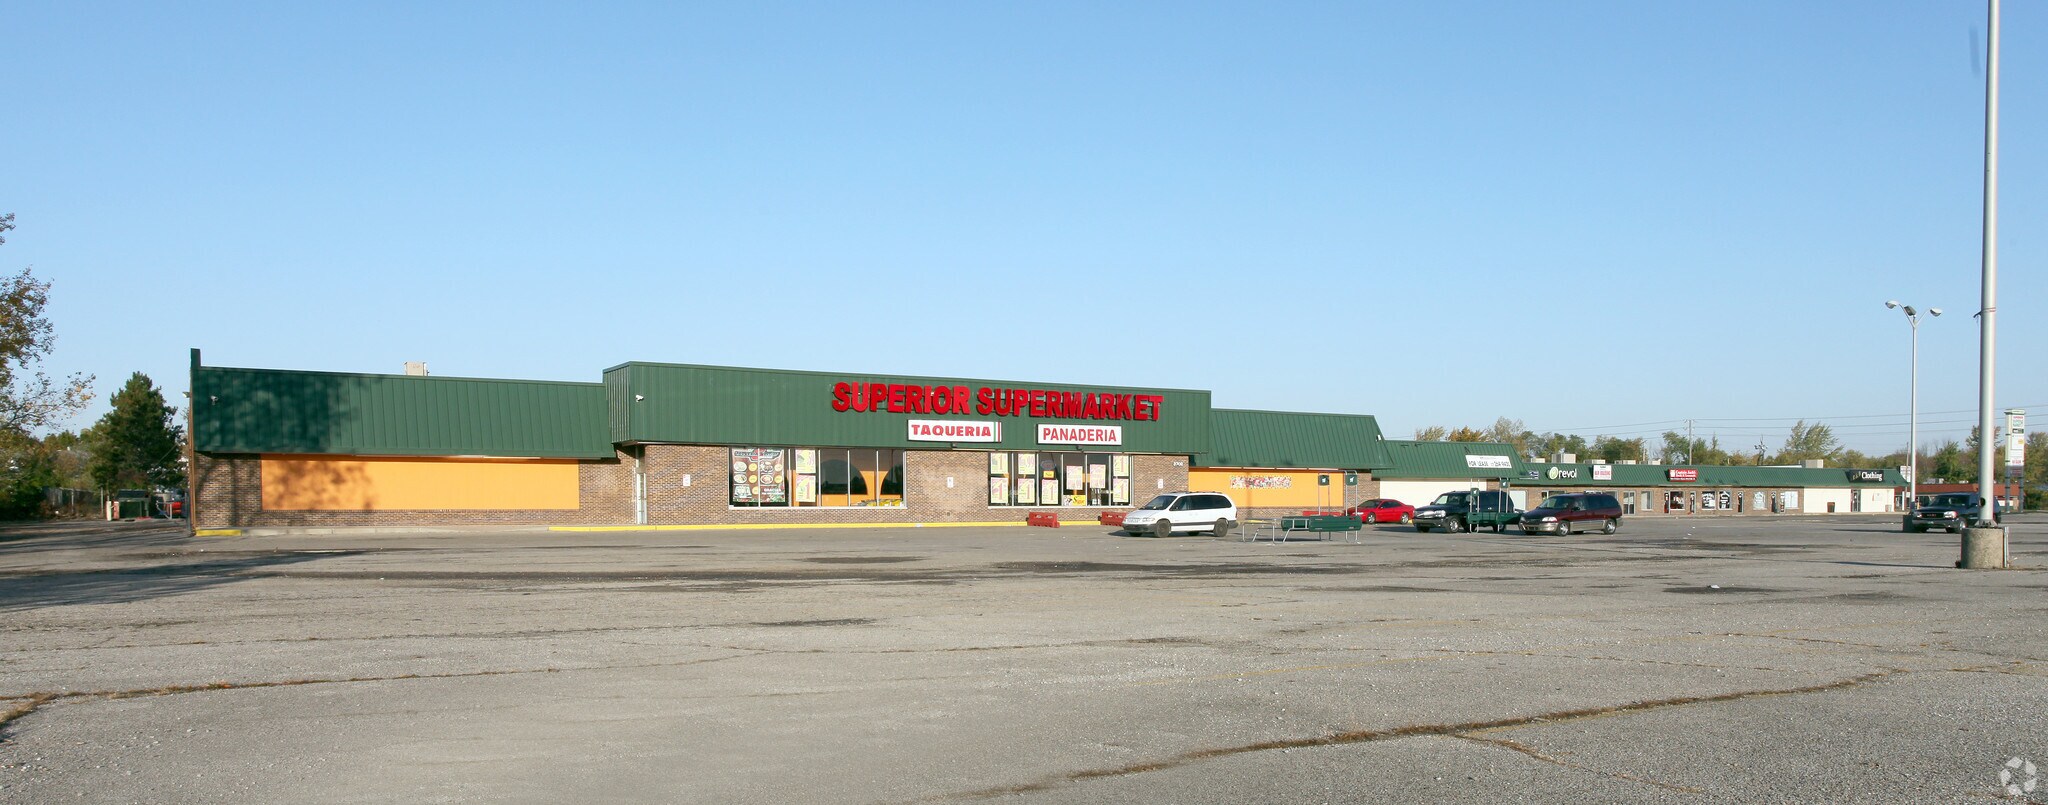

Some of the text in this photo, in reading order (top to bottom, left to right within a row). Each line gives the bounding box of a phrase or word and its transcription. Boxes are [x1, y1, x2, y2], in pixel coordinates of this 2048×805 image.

[832, 381, 1164, 421] SUPERIOR SUPERMARKET
[911, 424, 991, 437] TAQUERIA
[1043, 427, 1117, 442] PANADERIA
[1558, 468, 1578, 479] revol
[1861, 471, 1883, 482] Clothing
